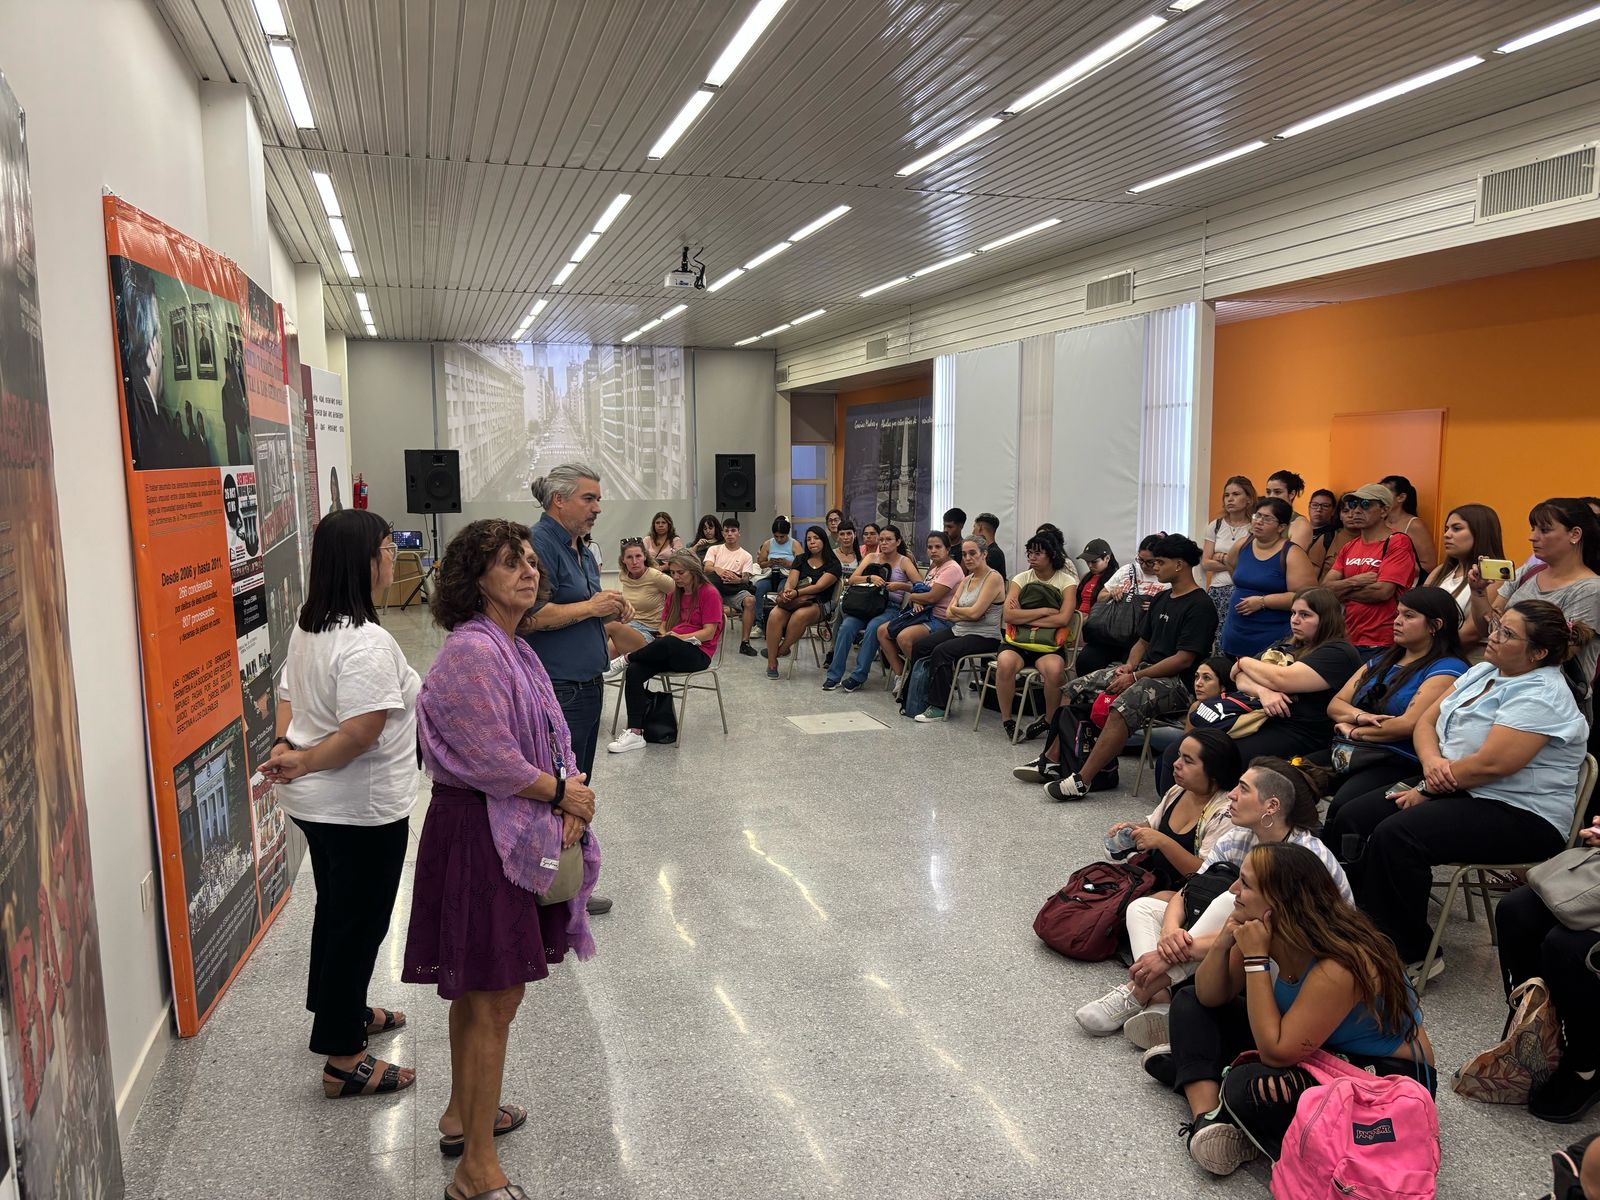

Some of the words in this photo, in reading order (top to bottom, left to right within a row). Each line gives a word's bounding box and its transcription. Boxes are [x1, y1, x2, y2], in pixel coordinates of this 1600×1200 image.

[162, 570, 180, 587] Desde
[180, 564, 193, 581] 2006
[193, 566, 197, 580] y
[197, 562, 210, 575] hasta
[188, 579, 213, 596] condenados
[191, 606, 216, 627] procesados
[1196, 702, 1220, 723] PUMA
